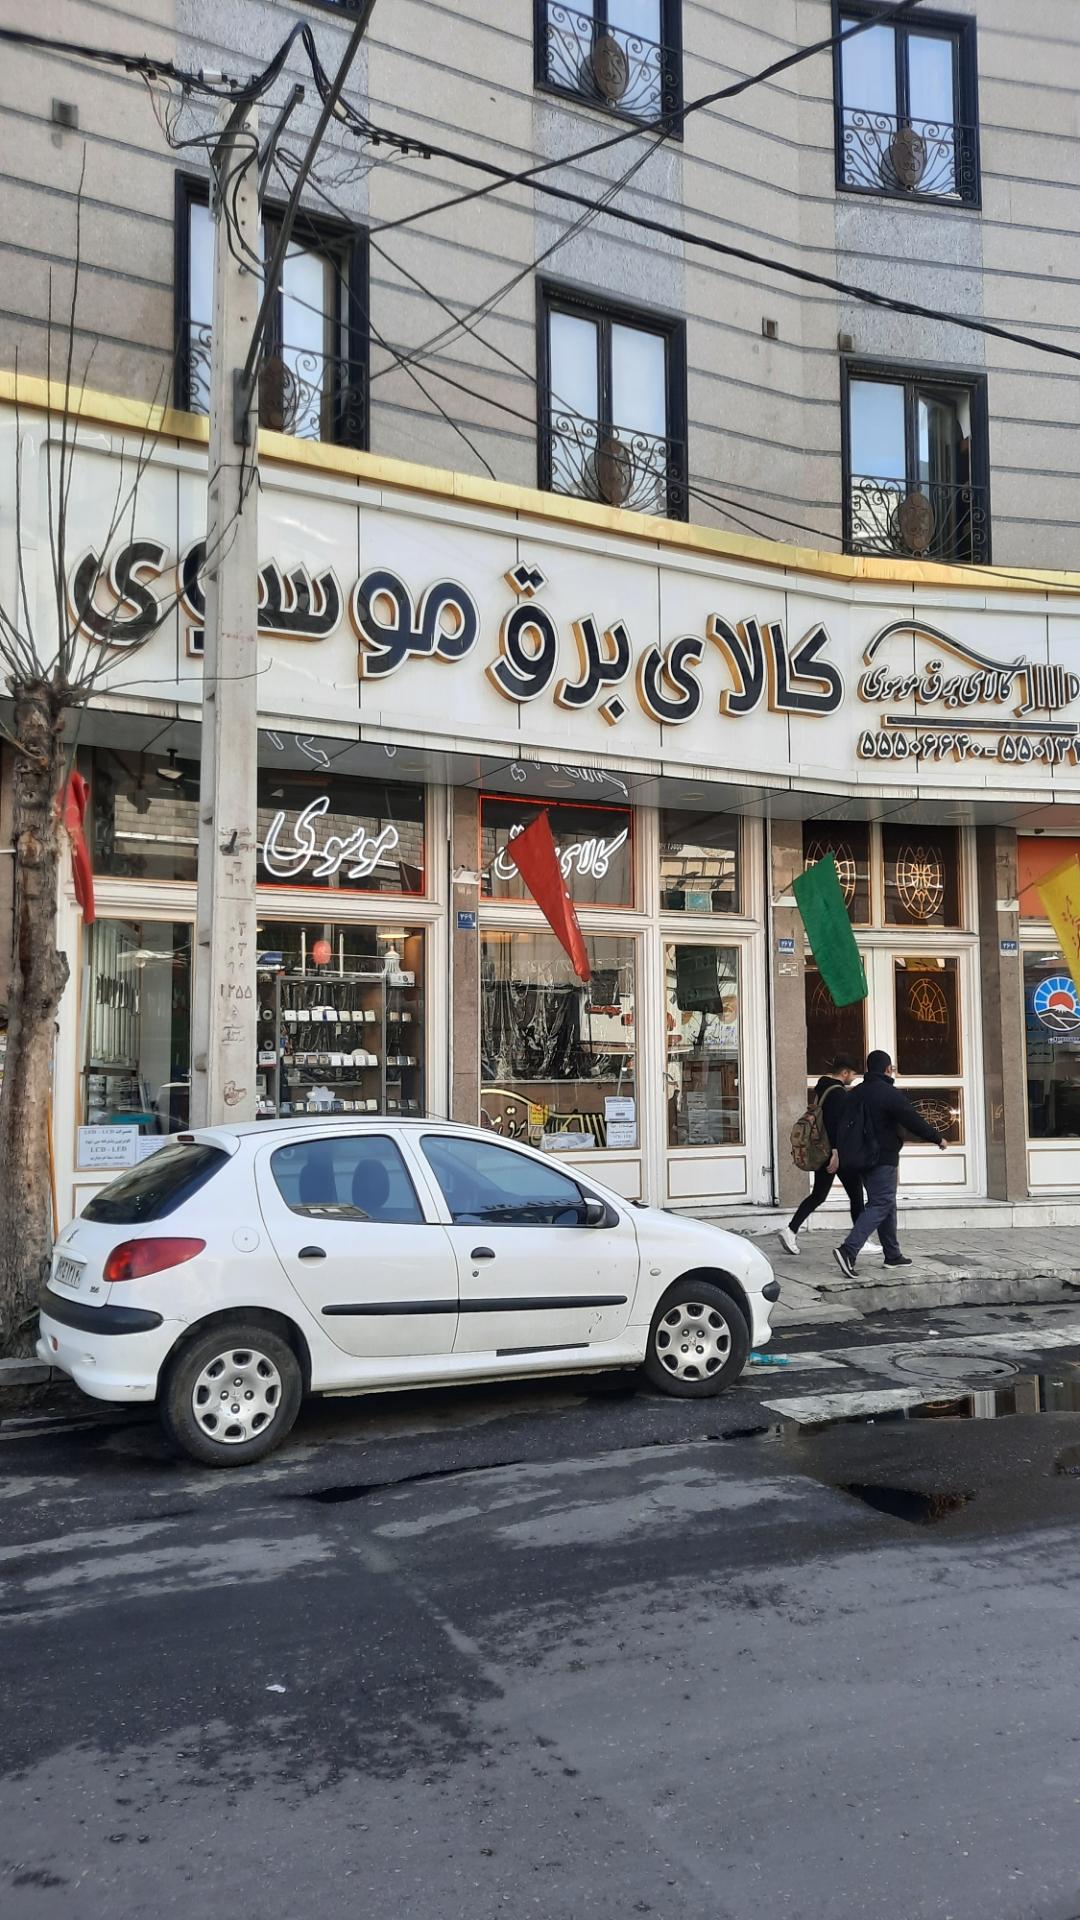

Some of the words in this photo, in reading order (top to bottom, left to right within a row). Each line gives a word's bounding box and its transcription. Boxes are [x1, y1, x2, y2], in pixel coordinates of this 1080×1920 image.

[486, 560, 633, 727] برق
[637, 612, 845, 725] کالای
[859, 666, 918, 702] موسوی
[917, 659, 962, 708] برق
[957, 655, 1027, 704] کالای
[264, 797, 399, 879] موسوی
